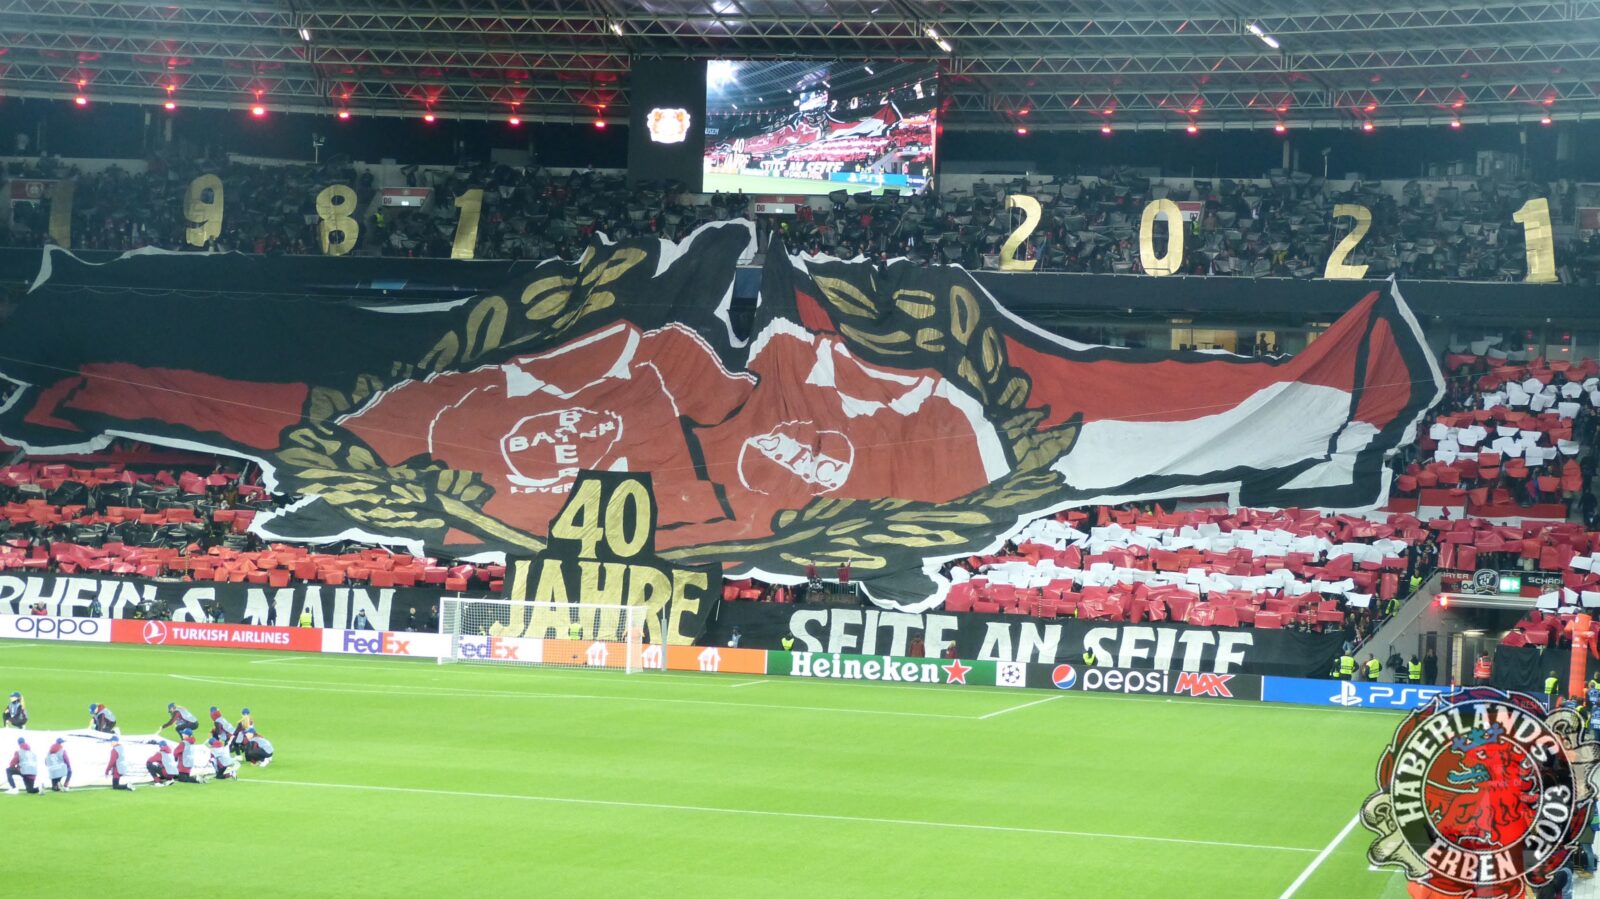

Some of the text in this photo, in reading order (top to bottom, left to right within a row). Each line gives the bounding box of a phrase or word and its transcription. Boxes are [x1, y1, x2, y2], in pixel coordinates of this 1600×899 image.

[551, 478, 651, 559] 40
[244, 585, 396, 632] MAIN
[489, 558, 708, 647] JAHRE
[15, 616, 98, 639] oppo
[172, 627, 290, 645] TURKISH AIRLINES
[789, 608, 1254, 674] SEITE AN SEITE
[343, 631, 410, 655] FedEx
[789, 651, 940, 683] Heineken
[1083, 668, 1235, 697] pepsi MAX
[1369, 685, 1441, 706] PS5
